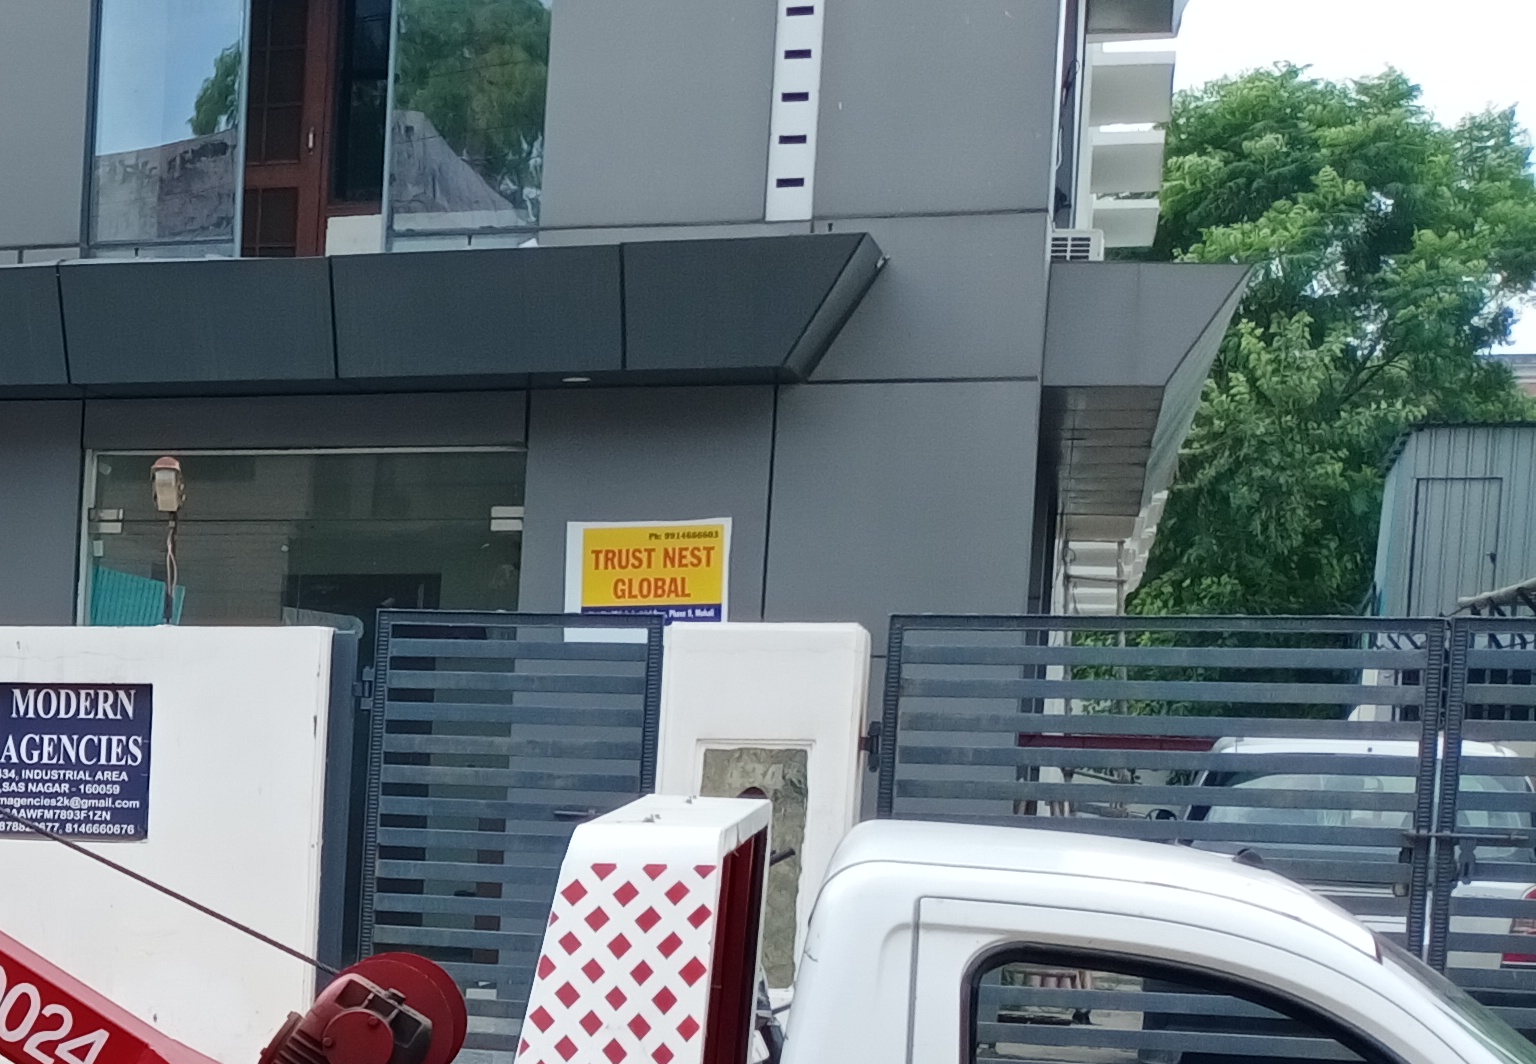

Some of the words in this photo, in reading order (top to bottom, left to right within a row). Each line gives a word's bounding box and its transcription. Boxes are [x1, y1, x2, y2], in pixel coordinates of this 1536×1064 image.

[591, 548, 656, 570] TRUST
[663, 546, 715, 568] NEST
[613, 577, 691, 599] GLOBAL
[11, 688, 136, 720] MODERN
[0, 734, 143, 766] AGENCIES
[22, 769, 93, 780] INDUSTRIAL
[95, 770, 128, 781] AREA
[28, 782, 69, 793] NAGAR
[78, 784, 120, 795] 160059
